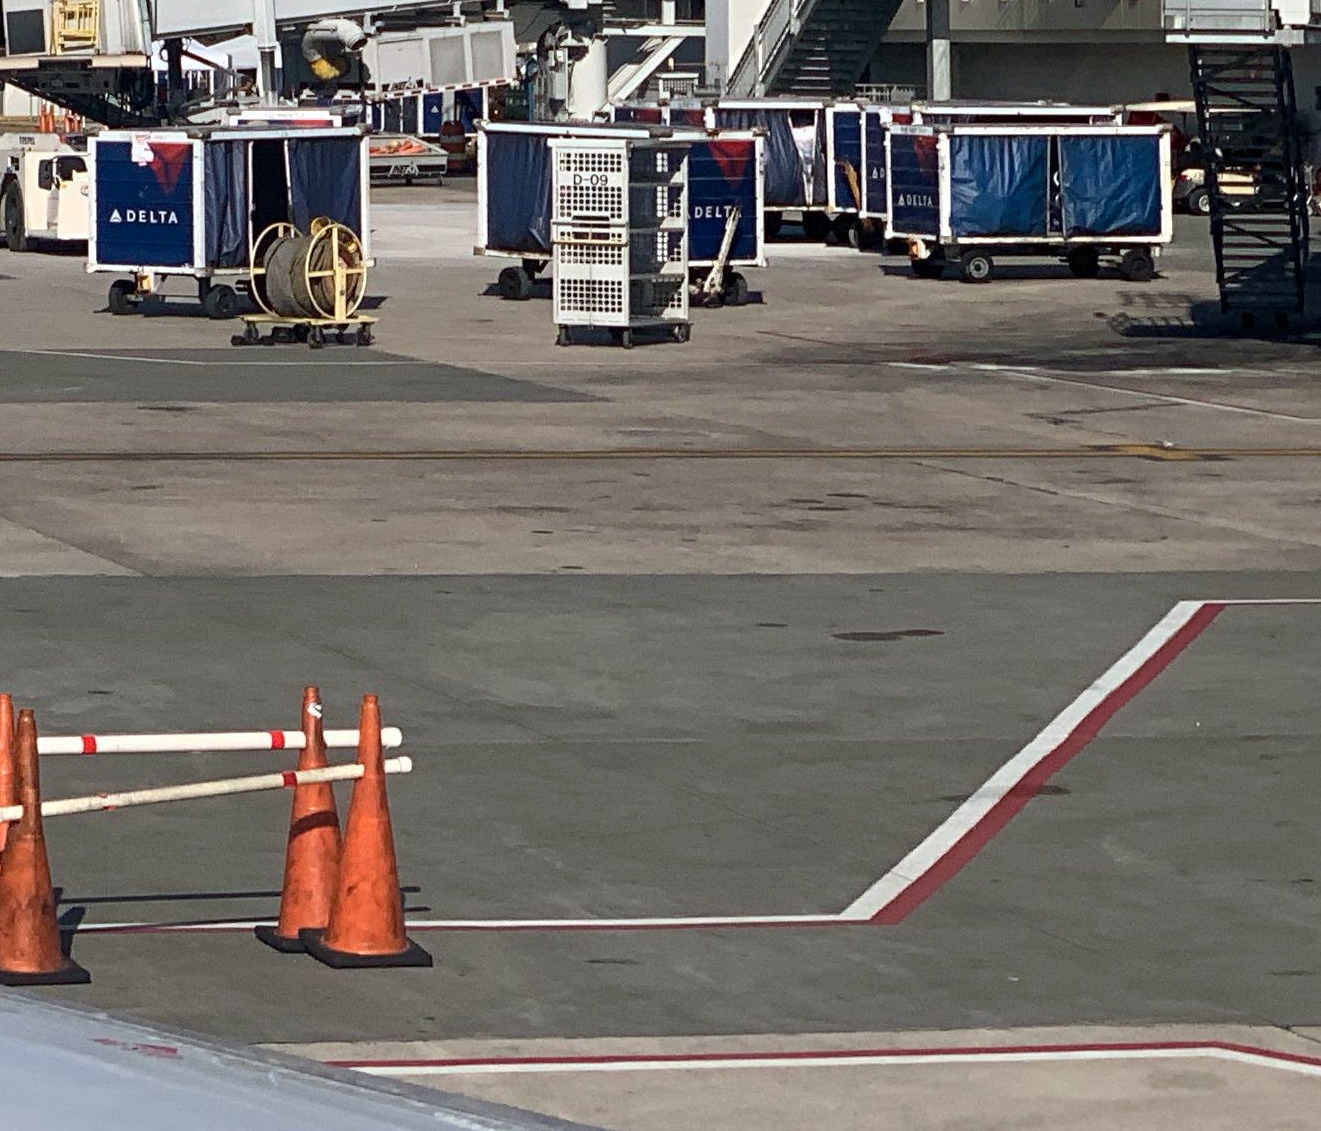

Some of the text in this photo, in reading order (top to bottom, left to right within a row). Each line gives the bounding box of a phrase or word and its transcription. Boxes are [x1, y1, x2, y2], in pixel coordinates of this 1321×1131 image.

[573, 174, 608, 186] D-09
[907, 196, 933, 207] DELTA
[126, 208, 178, 224] DELTA
